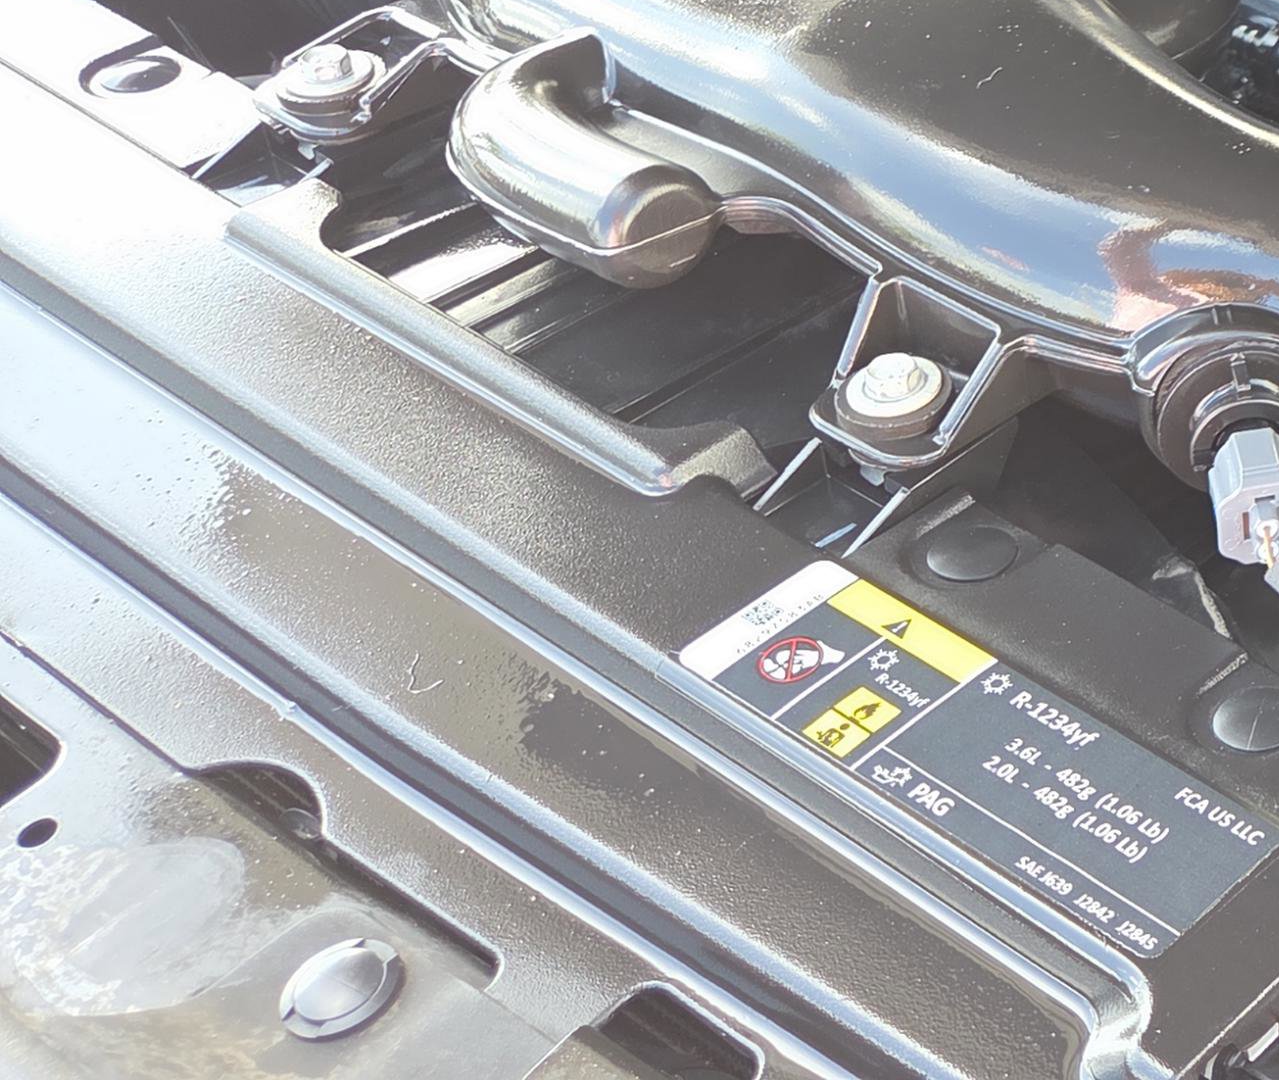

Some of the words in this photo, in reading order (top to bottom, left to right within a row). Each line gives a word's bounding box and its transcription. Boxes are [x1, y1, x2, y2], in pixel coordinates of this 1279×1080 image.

[875, 672, 930, 710] R-1234yf
[1008, 690, 1102, 751] R-1234yf
[907, 781, 956, 818] PAG
[981, 755, 1018, 787] 2.0L
[1033, 786, 1076, 822] 482g
[1073, 810, 1119, 847] (1.06
[1115, 834, 1150, 865] Lb)
[1003, 736, 1040, 769] 3.6L
[1055, 767, 1097, 802] 482g
[1095, 790, 1140, 828] (1.06
[1137, 814, 1171, 846] Lb)
[1174, 786, 1208, 815] FCA
[1209, 805, 1234, 832] US
[1230, 819, 1266, 848] LLC
[1014, 855, 1044, 879] SAE
[1038, 869, 1074, 897] J639
[1074, 892, 1116, 925] J2842
[1116, 919, 1159, 952] J2845
